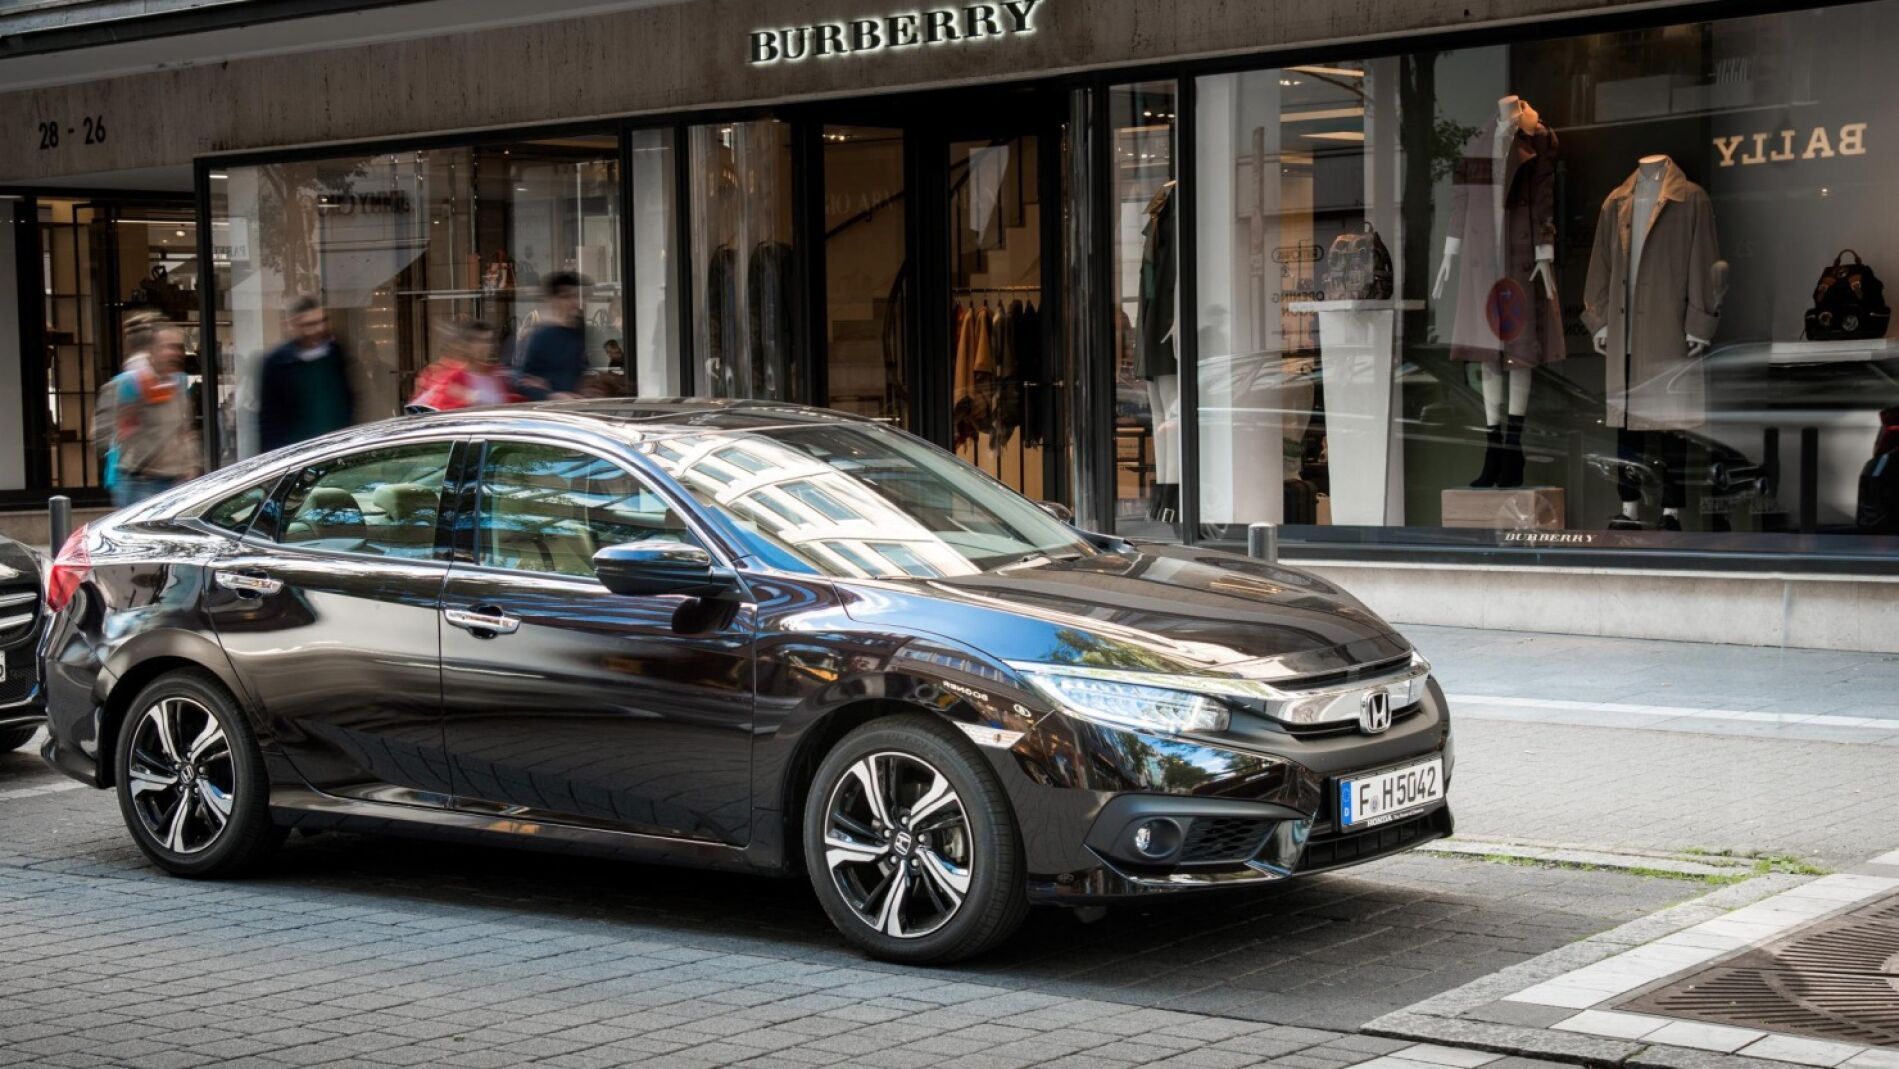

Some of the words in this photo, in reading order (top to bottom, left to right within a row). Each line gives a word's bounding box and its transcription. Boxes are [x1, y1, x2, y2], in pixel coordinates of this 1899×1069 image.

[749, 0, 1041, 64] BURBERRY
[39, 121, 59, 150] 28
[83, 115, 106, 145] 26
[1504, 533, 1597, 544] BURBERRY
[1359, 783, 1371, 816] F
[1344, 806, 1350, 817] D
[1367, 815, 1393, 827] HONDA
